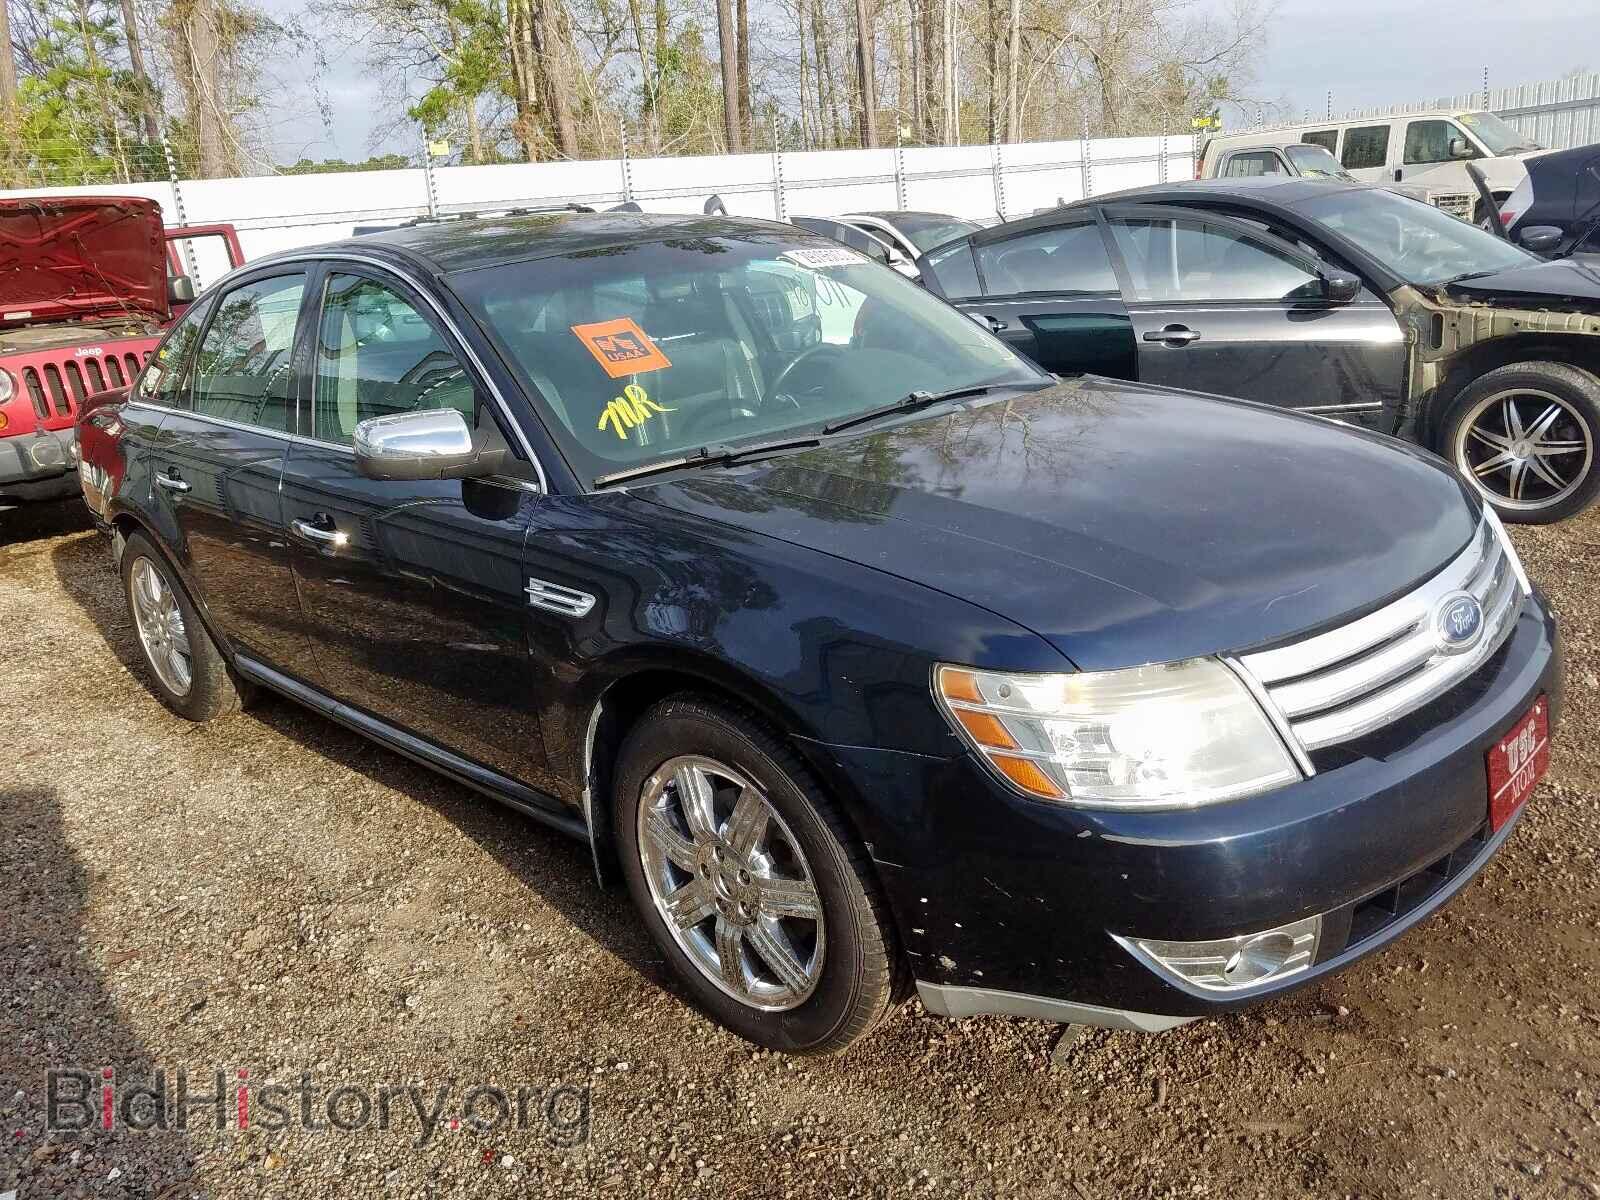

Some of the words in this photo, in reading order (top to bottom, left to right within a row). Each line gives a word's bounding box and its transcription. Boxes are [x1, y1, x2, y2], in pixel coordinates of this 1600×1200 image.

[75, 347, 103, 357] Jeep
[1451, 605, 1475, 635] Ford
[1507, 718, 1536, 775] USC
[1511, 759, 1536, 804] MOM
